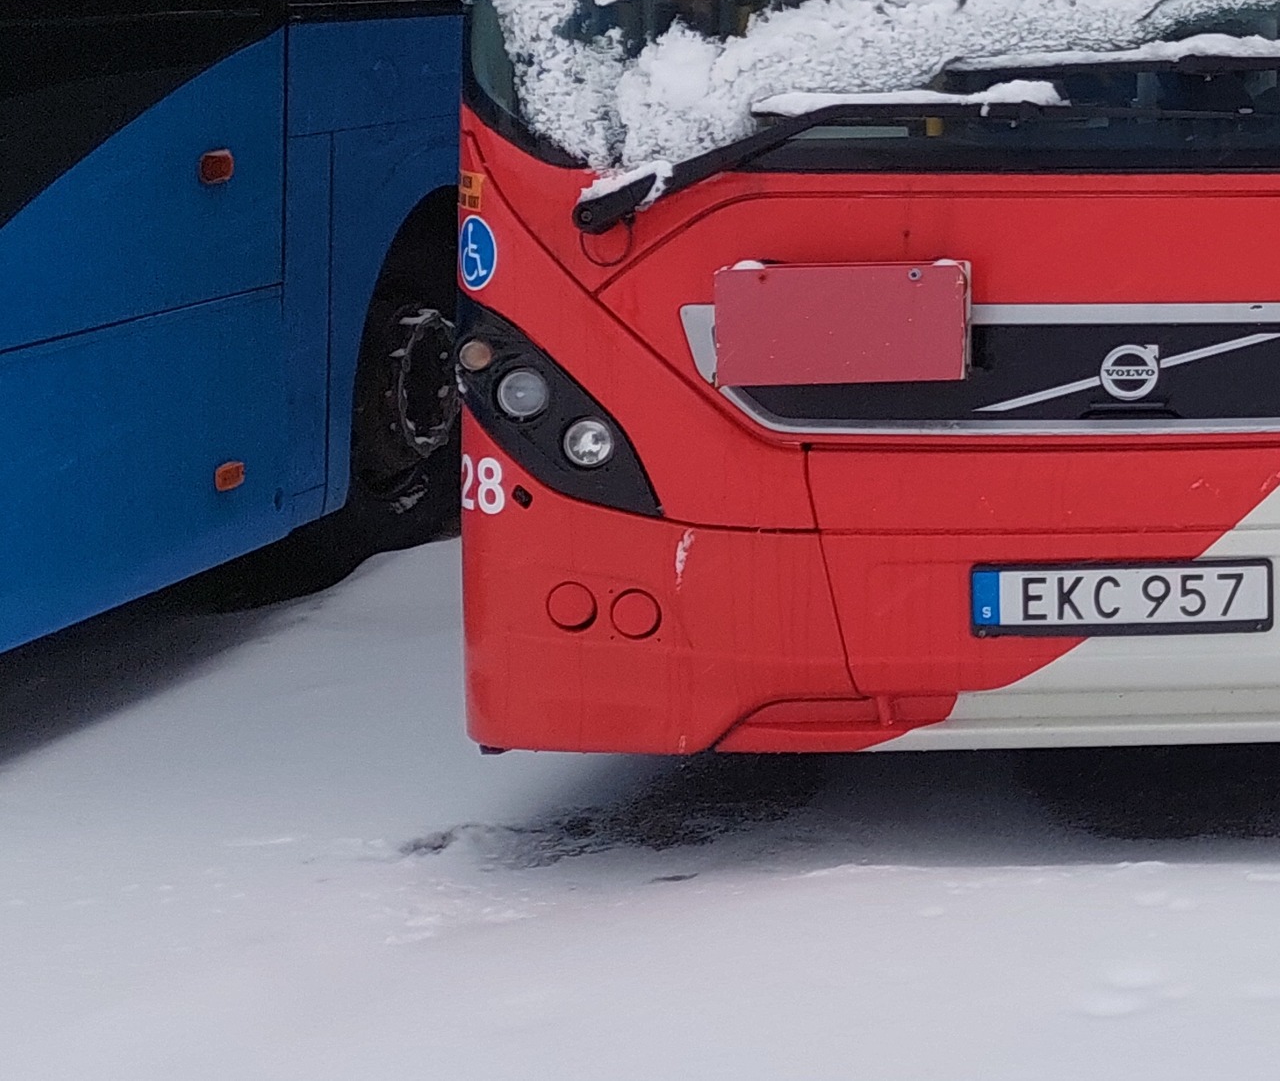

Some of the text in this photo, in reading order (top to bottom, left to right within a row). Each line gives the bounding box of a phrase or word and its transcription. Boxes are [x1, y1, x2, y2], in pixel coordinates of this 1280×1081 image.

[1103, 368, 1156, 377] VOLVO
[982, 573, 1244, 621] S EKC 957
